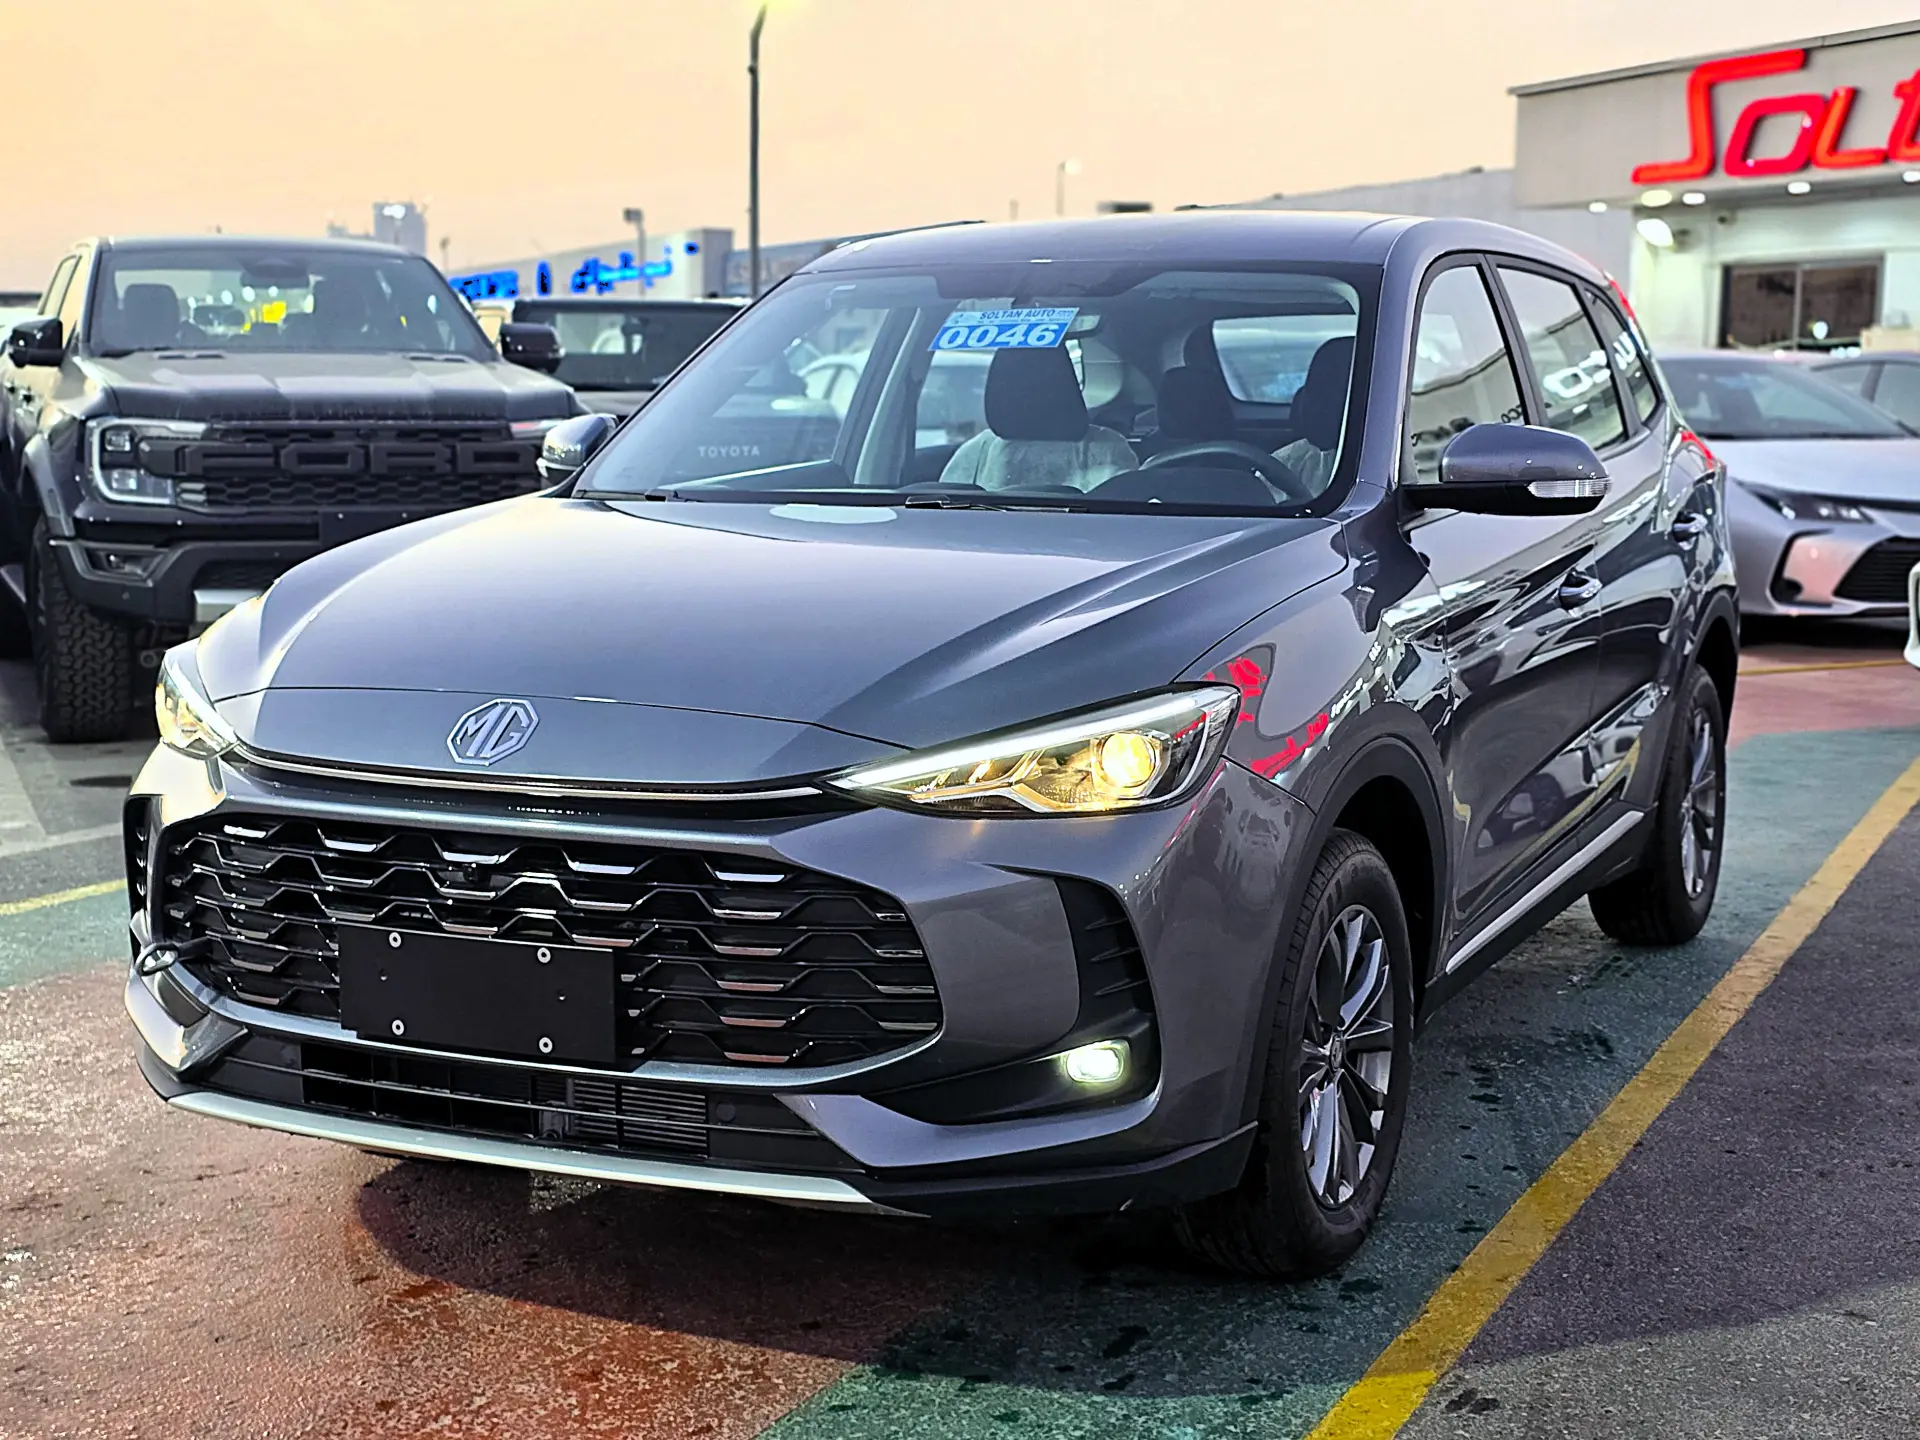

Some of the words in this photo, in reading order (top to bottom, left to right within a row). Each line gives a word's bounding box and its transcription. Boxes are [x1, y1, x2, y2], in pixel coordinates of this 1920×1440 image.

[980, 310, 1022, 320] SOLTAN
[1024, 308, 1056, 318] AUTO
[938, 323, 1059, 349] 0046
[186, 441, 538, 476] FORD
[698, 445, 760, 459] TOYOTA
[455, 703, 531, 758] MG
